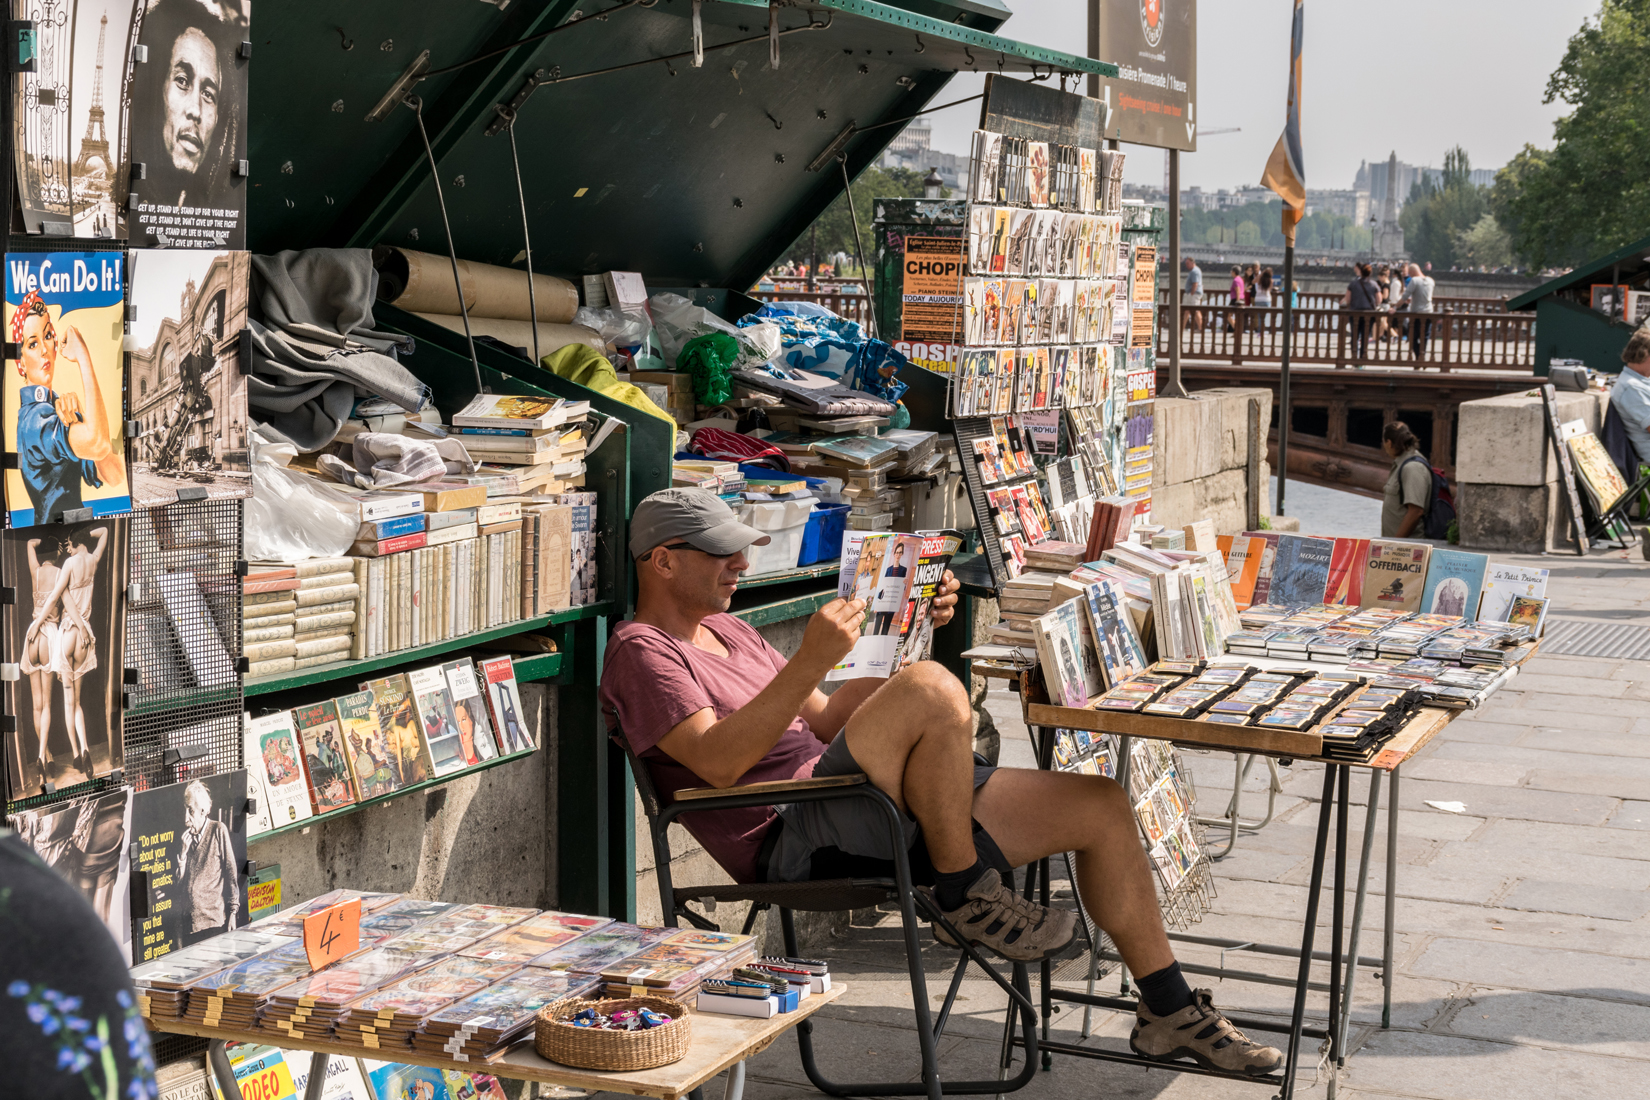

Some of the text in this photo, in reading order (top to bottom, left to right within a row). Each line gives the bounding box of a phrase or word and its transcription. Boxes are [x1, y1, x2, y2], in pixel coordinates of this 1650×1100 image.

[1114, 62, 1138, 82] oisière
[1138, 67, 1166, 88] Promenade
[1174, 76, 1186, 93] heure
[1119, 92, 1146, 114] Sightseeing
[138, 204, 147, 212] GET
[157, 205, 172, 214] STAND
[180, 207, 194, 215] STAND
[195, 208, 202, 216] UP
[212, 208, 224, 216] YOUR
[225, 210, 239, 218] RIGHT
[140, 215, 149, 223] GET
[158, 216, 174, 224] STAND
[182, 217, 196, 226] DON'T
[196, 218, 206, 226] GIVE
[214, 220, 224, 228] THE
[224, 220, 237, 228] FIGHT
[146, 226, 156, 234] GET
[216, 230, 230, 238] RIGHT
[175, 238, 186, 247] GIVE
[186, 239, 193, 247] UP
[194, 240, 202, 248] THE
[10, 259, 120, 294] We Can Do It!
[1136, 269, 1154, 282] CHOPIN
[894, 342, 961, 362] GOSP
[1128, 372, 1155, 392] GOSPEL
[846, 548, 860, 556] Vive
[920, 540, 944, 555] PRESS
[1299, 552, 1330, 561] MOZART
[913, 562, 945, 584] ANGENT
[1370, 560, 1422, 573] OFFENBACH
[1494, 571, 1542, 583] Le Petit Prince
[456, 677, 470, 686] ZWEIG
[346, 694, 367, 707] PARADIS
[379, 692, 404, 706] SÜSKIND
[300, 706, 323, 720] Le soleil
[352, 706, 369, 717] PERDU
[384, 706, 390, 714] Le
[306, 712, 335, 727] se lève aussi
[272, 784, 302, 797] UN AMOUR
[286, 793, 304, 804] SWANN
[150, 834, 159, 845] not
[160, 830, 174, 843] worry
[139, 847, 166, 863] about your
[166, 860, 171, 870] in
[152, 874, 173, 889] ematics;
[248, 884, 276, 902] UÉRISON
[155, 899, 172, 912] assure
[251, 895, 275, 910] DALTON
[143, 915, 162, 934] you that
[144, 931, 164, 946] mine are
[144, 947, 152, 960] still
[325, 1059, 349, 1079] AGALL
[192, 1082, 205, 1094] GR
[243, 1070, 279, 1100] ODEO
